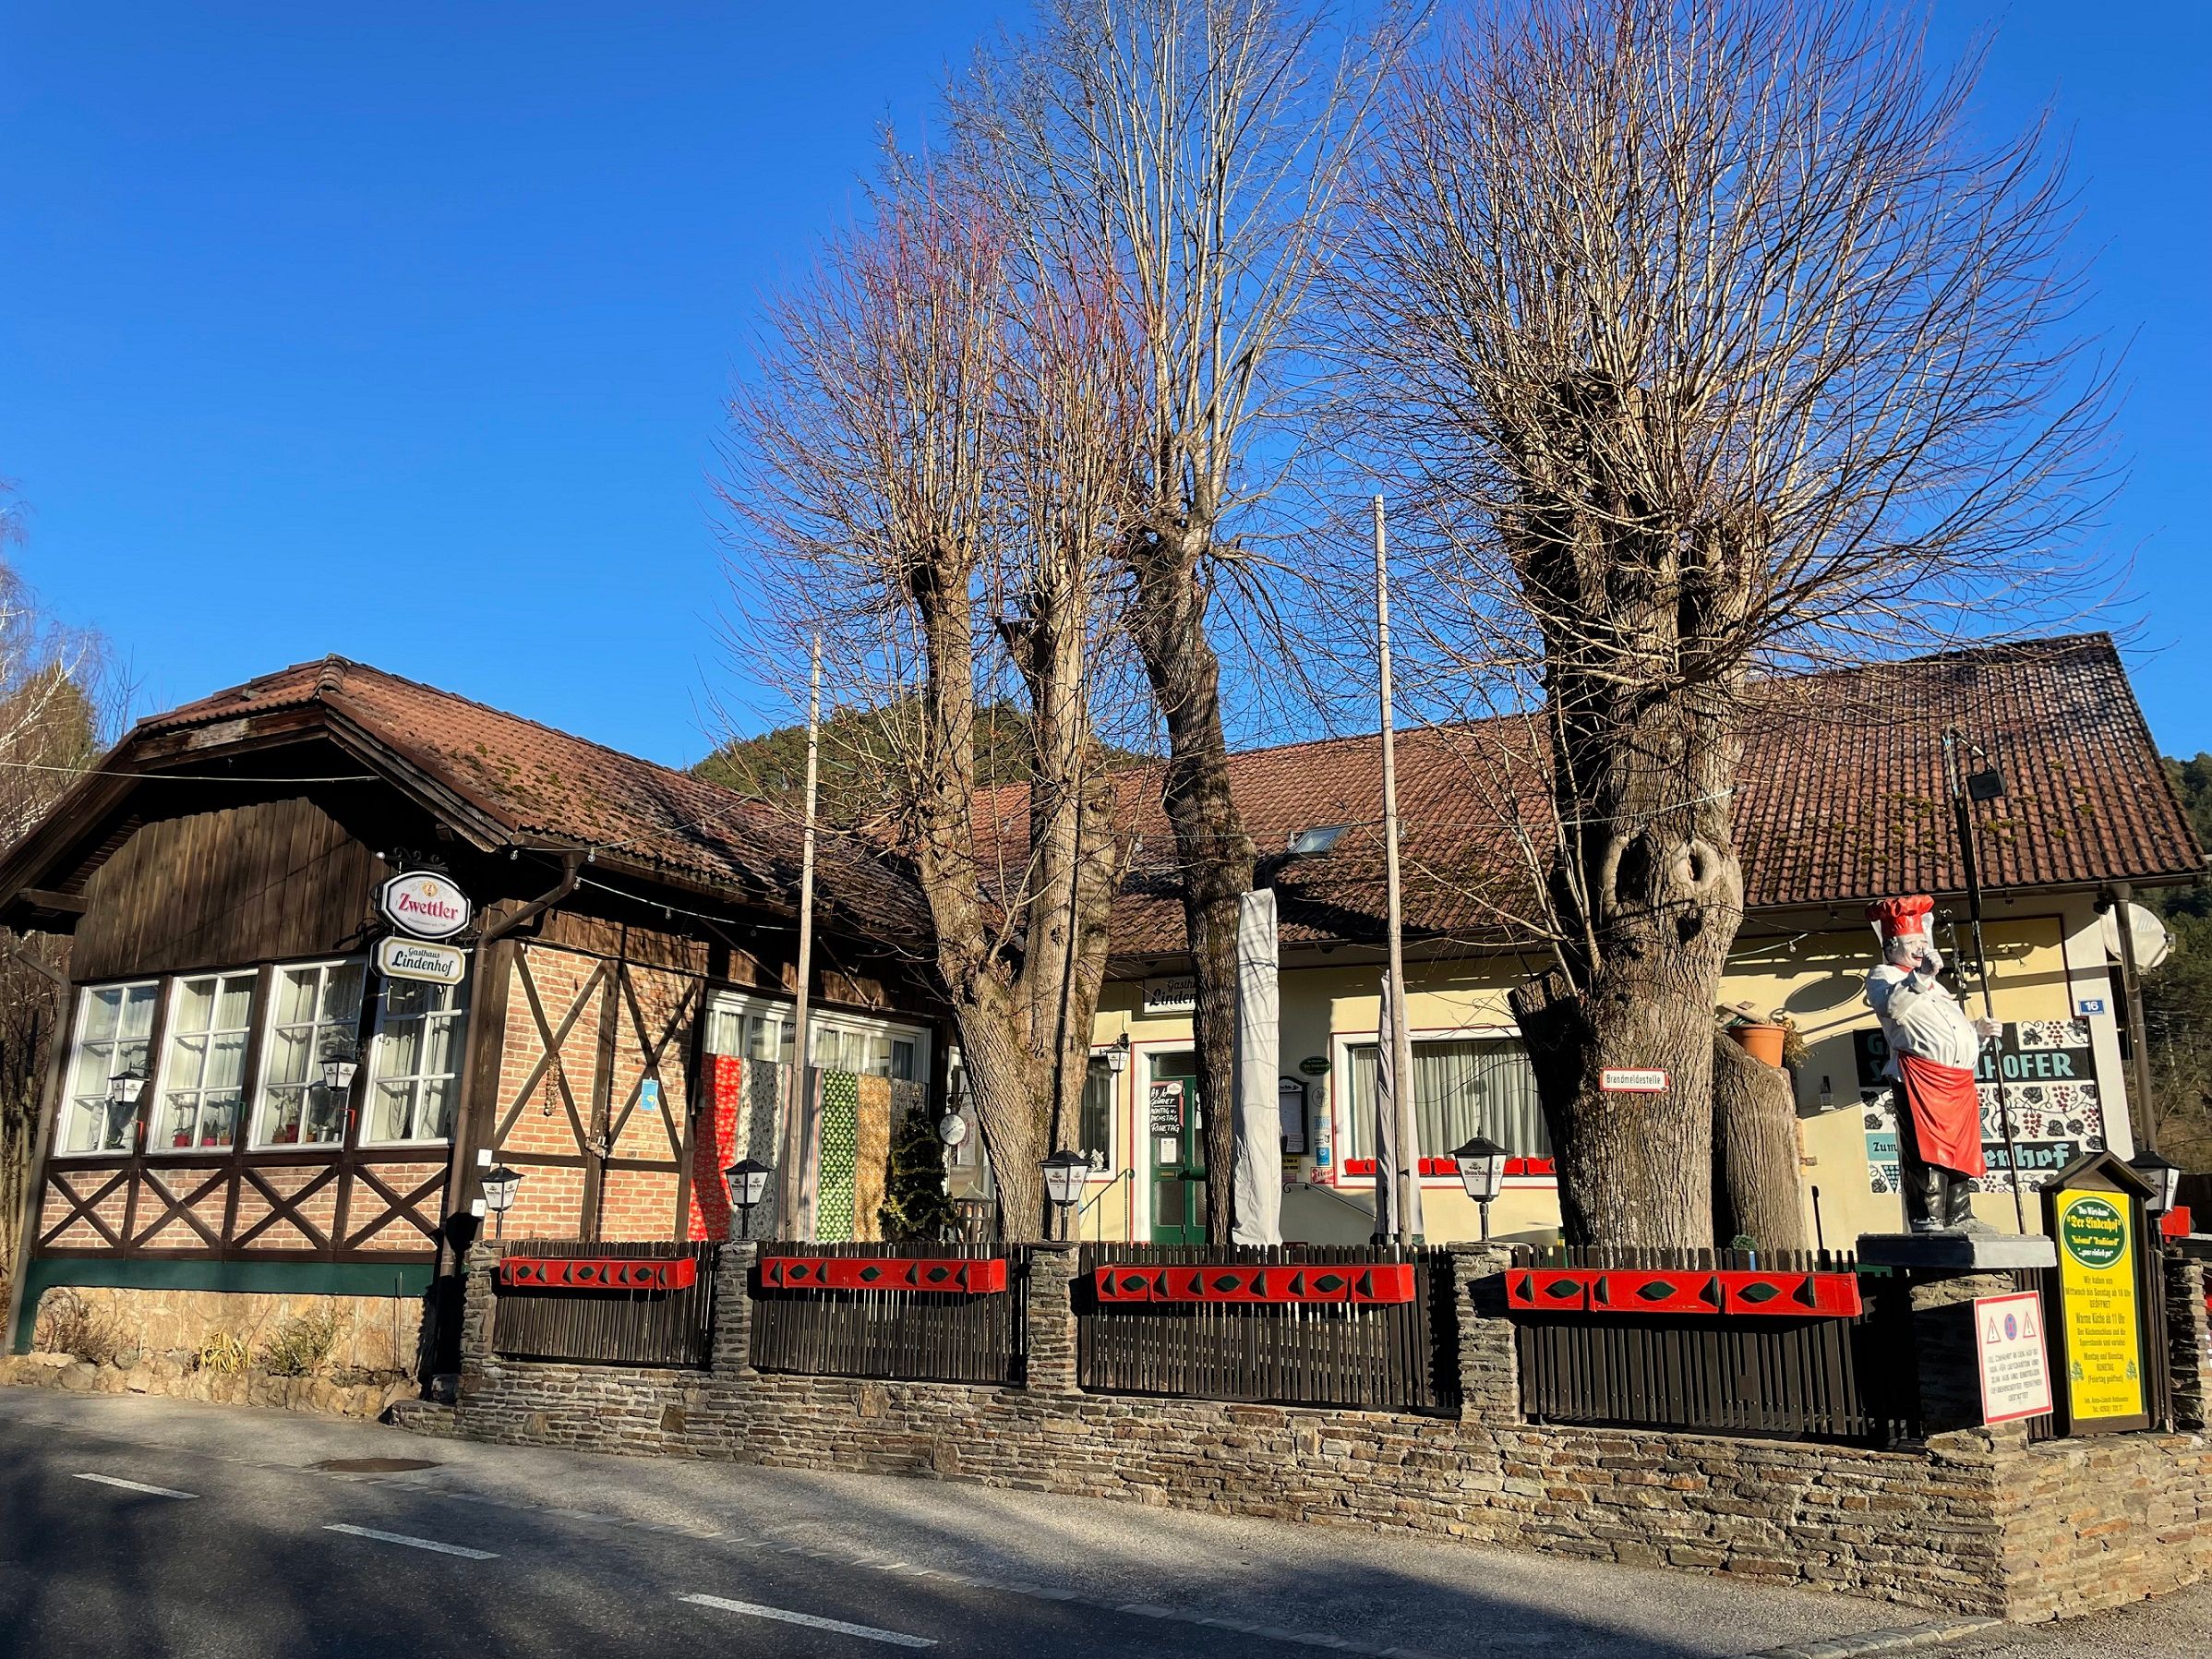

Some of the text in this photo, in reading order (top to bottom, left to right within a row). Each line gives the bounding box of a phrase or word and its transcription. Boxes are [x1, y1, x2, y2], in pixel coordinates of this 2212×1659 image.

[398, 893, 458, 920] Zwettler
[408, 947, 440, 959] Gasthaus
[391, 950, 454, 977] Lindenhof
[1167, 979, 1195, 992] Gasth
[1149, 989, 1196, 1006] Linden
[2085, 1001, 2098, 1011] 16
[1606, 1074, 1661, 1085] Brandmeldestelle
[1150, 1123, 1180, 1134] RUHETAG
[1872, 1141, 1897, 1152] Zum
[1982, 1143, 2070, 1169] enhof
[2066, 1287, 2086, 1296] Mittwoch
[2095, 1288, 2110, 1298] Sonntag
[2090, 1298, 2110, 1308] GEÖFFNET
[2076, 1313, 2091, 1324] Warme
[2106, 1314, 2111, 1324] ab
[2111, 1314, 2117, 1324] 11
[2085, 1352, 2099, 1362] Montag
[2109, 1352, 2123, 1362] Dienstag
